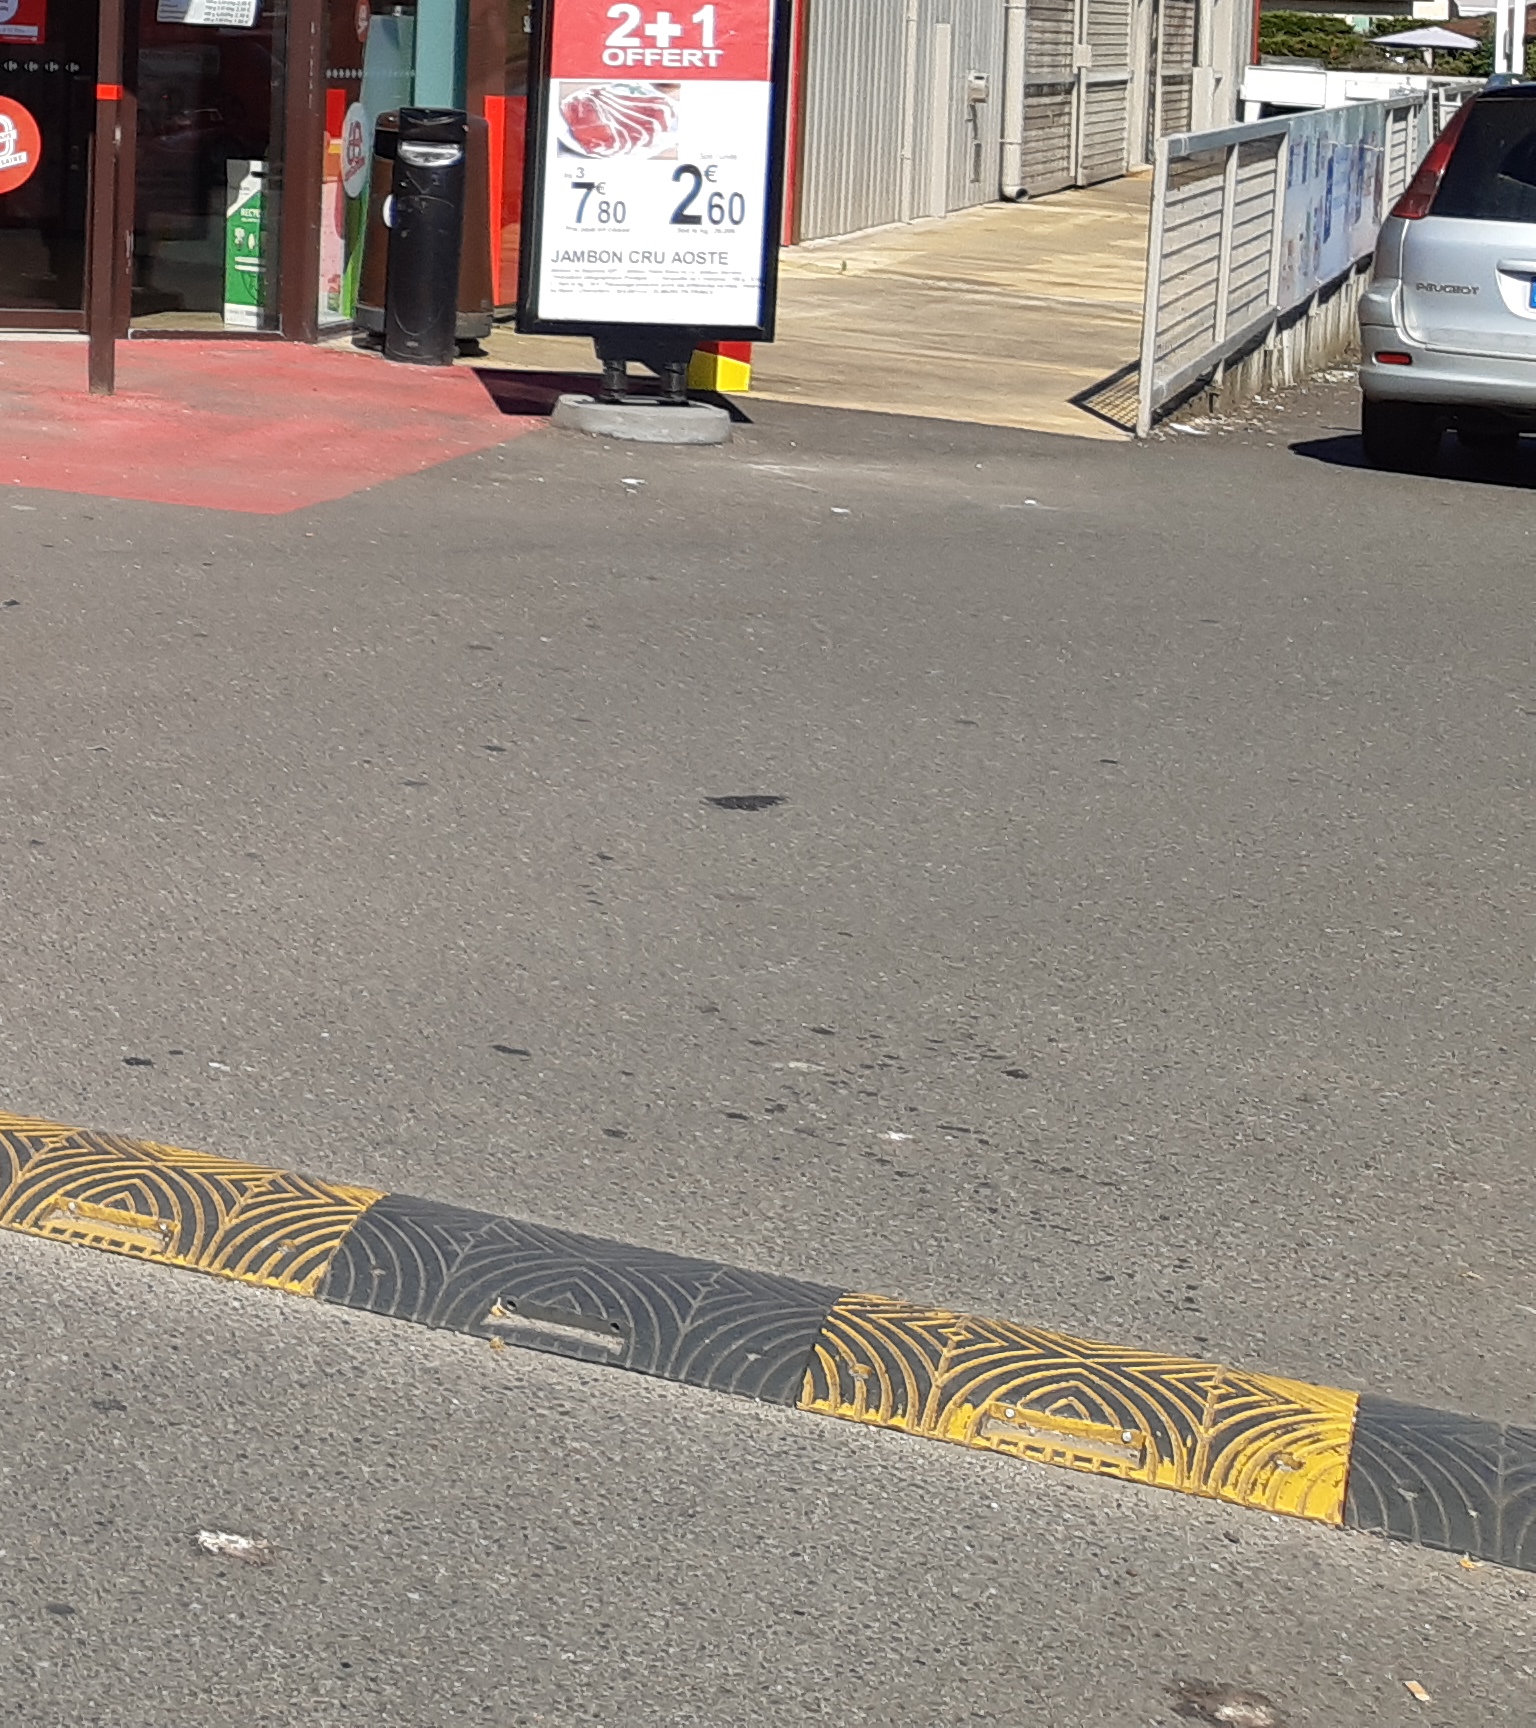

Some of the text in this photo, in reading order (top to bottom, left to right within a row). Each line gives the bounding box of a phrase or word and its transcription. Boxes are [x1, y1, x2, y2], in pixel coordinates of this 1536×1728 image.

[604, 2, 717, 48] 2+1
[601, 48, 724, 68] OFFERT
[576, 166, 585, 179] 3
[550, 249, 729, 266] JAMBON CRU AOSTE
[1415, 282, 1480, 295] PEUGEOT
